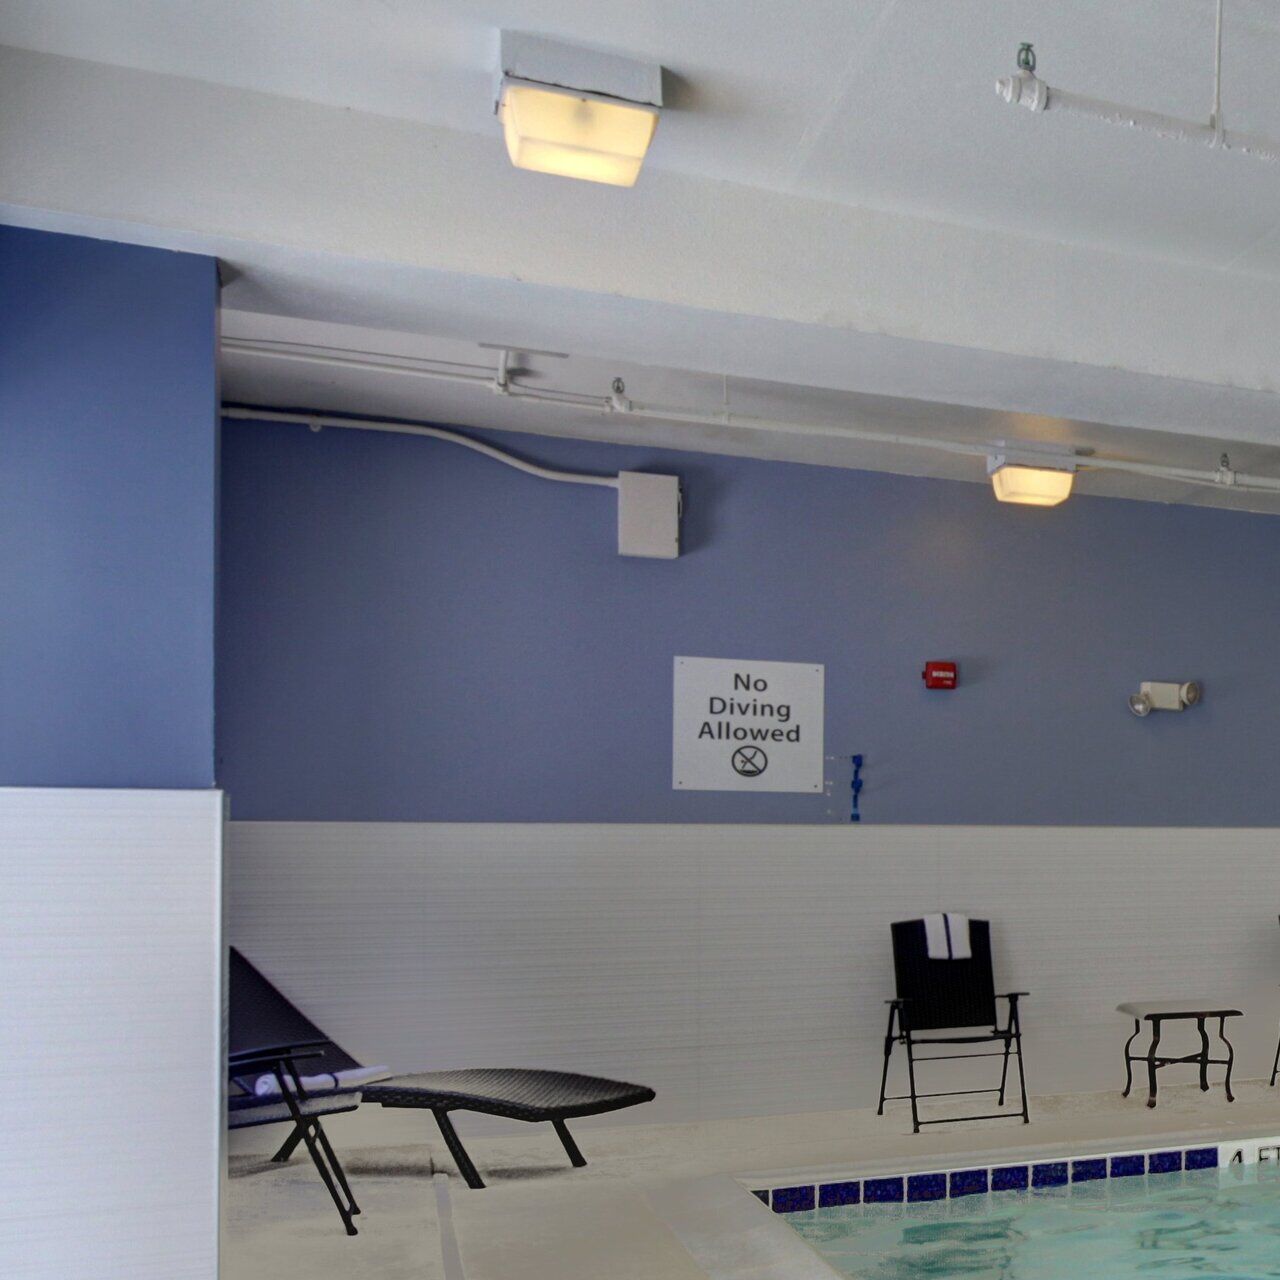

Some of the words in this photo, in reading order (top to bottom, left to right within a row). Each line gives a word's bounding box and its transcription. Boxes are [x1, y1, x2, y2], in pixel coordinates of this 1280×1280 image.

[733, 673, 768, 692] No
[709, 697, 791, 722] Diving
[698, 721, 800, 743] Allowed
[1231, 1148, 1243, 1164] 4
